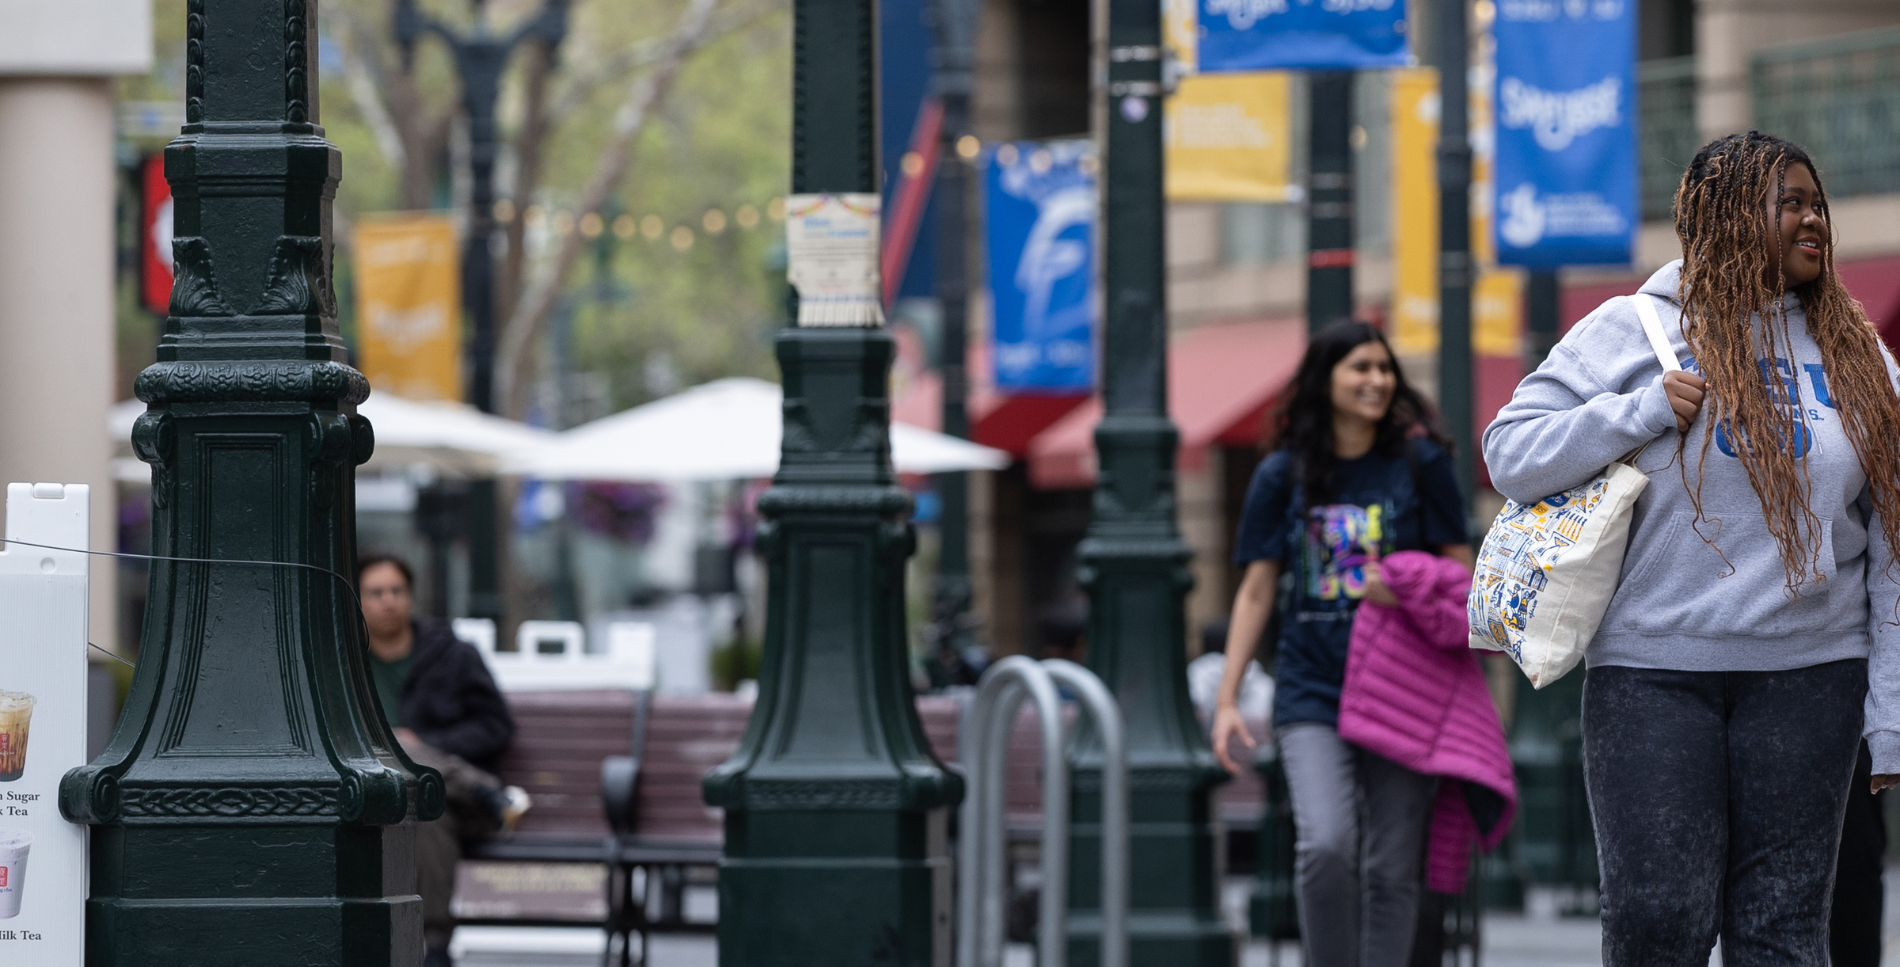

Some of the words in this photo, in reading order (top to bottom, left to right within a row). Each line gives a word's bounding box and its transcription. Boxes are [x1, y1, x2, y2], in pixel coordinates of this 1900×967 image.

[6, 790, 41, 804] Sugar
[6, 805, 28, 816] Tea
[0, 930, 17, 941] ilk
[20, 930, 42, 941] Tea
